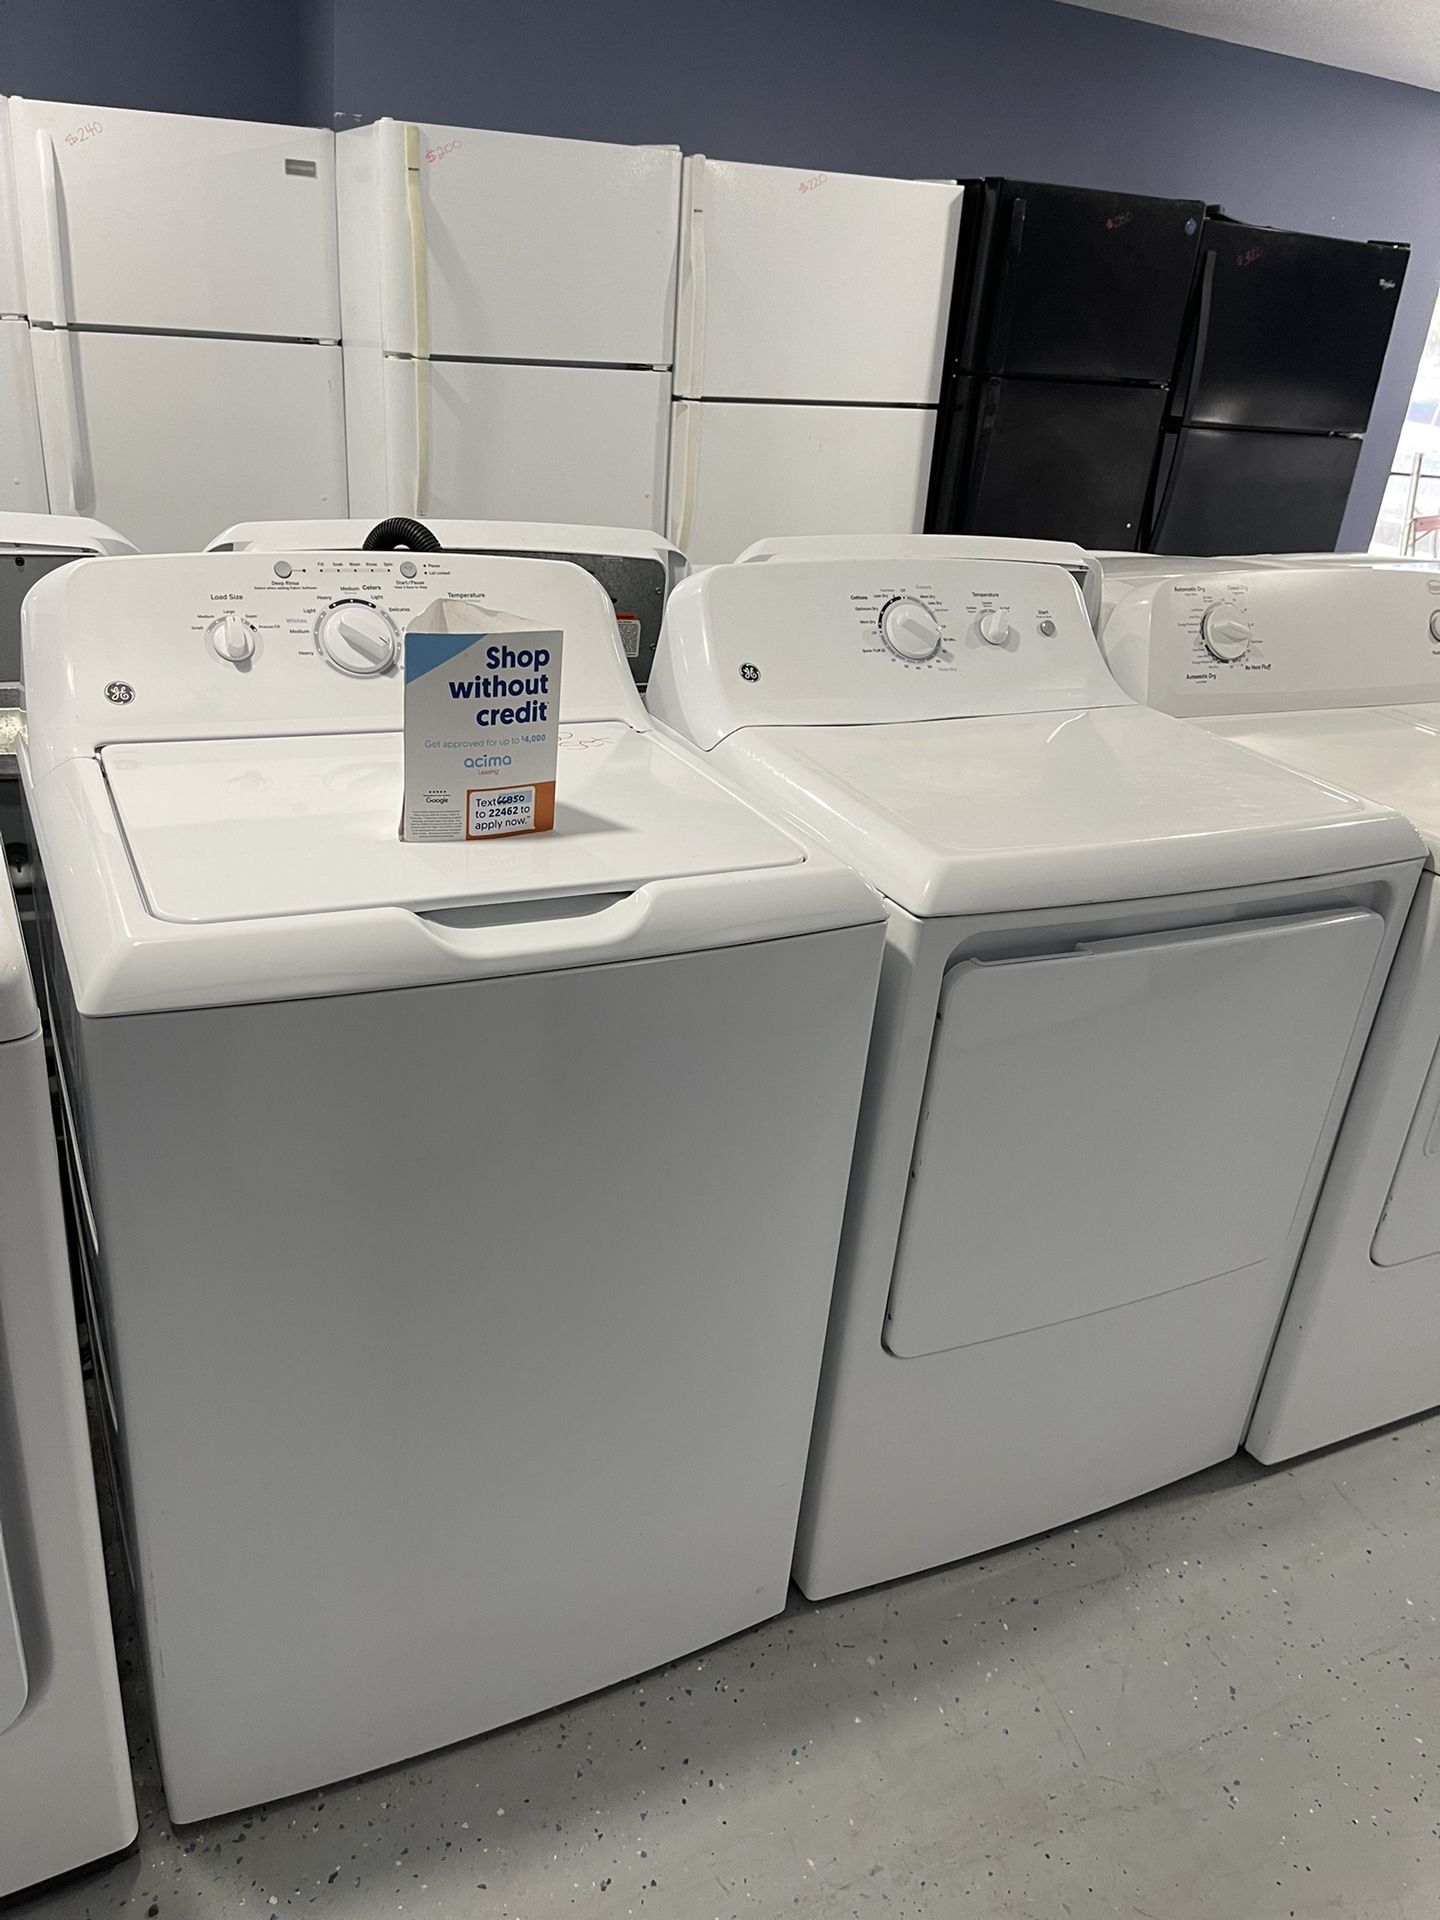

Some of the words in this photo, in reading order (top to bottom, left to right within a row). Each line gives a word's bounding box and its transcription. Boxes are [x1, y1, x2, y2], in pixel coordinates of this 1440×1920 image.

[65, 121, 103, 146] $240
[425, 140, 462, 163] $200
[447, 591, 486, 599] Temperature
[486, 645, 551, 673] Shop
[739, 662, 762, 684] GE
[104, 680, 136, 706] GE
[448, 674, 549, 699] without
[476, 699, 549, 727] credit
[424, 740, 441, 748] Get
[442, 739, 484, 749] approved
[486, 738, 498, 747] for
[499, 737, 510, 746] up
[463, 754, 513, 769] acima
[425, 797, 449, 805] Google
[475, 798, 497, 808] Text
[475, 811, 487, 819] to
[488, 806, 519, 818] 22462
[520, 806, 531, 814] to
[474, 820, 503, 831] apply
